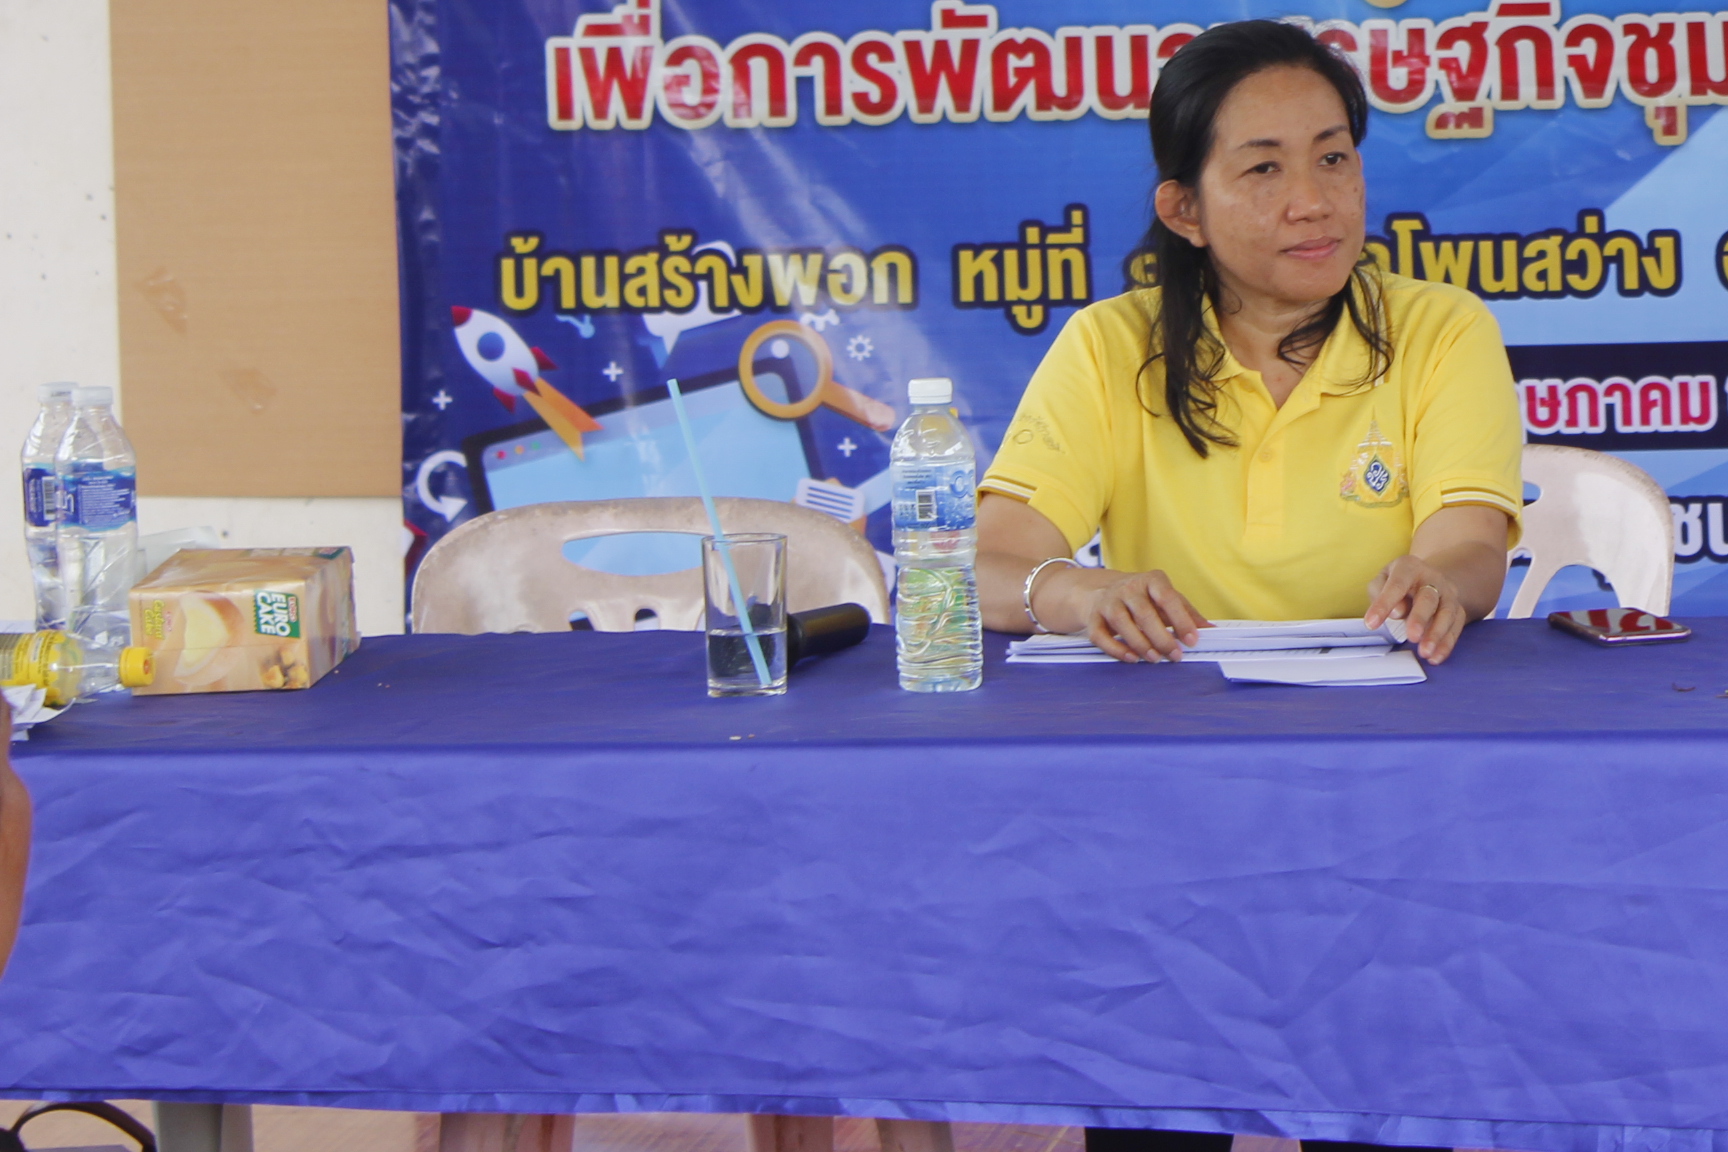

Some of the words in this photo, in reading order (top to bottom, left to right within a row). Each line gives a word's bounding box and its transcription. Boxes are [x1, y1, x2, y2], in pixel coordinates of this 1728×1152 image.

[498, 232, 917, 312] บ้านสร้างพอก
[957, 208, 1089, 330] หมู่ที่
[1520, 378, 1715, 434] ษภาคม
[256, 591, 276, 635] CAKE
[270, 592, 291, 637] EURO
